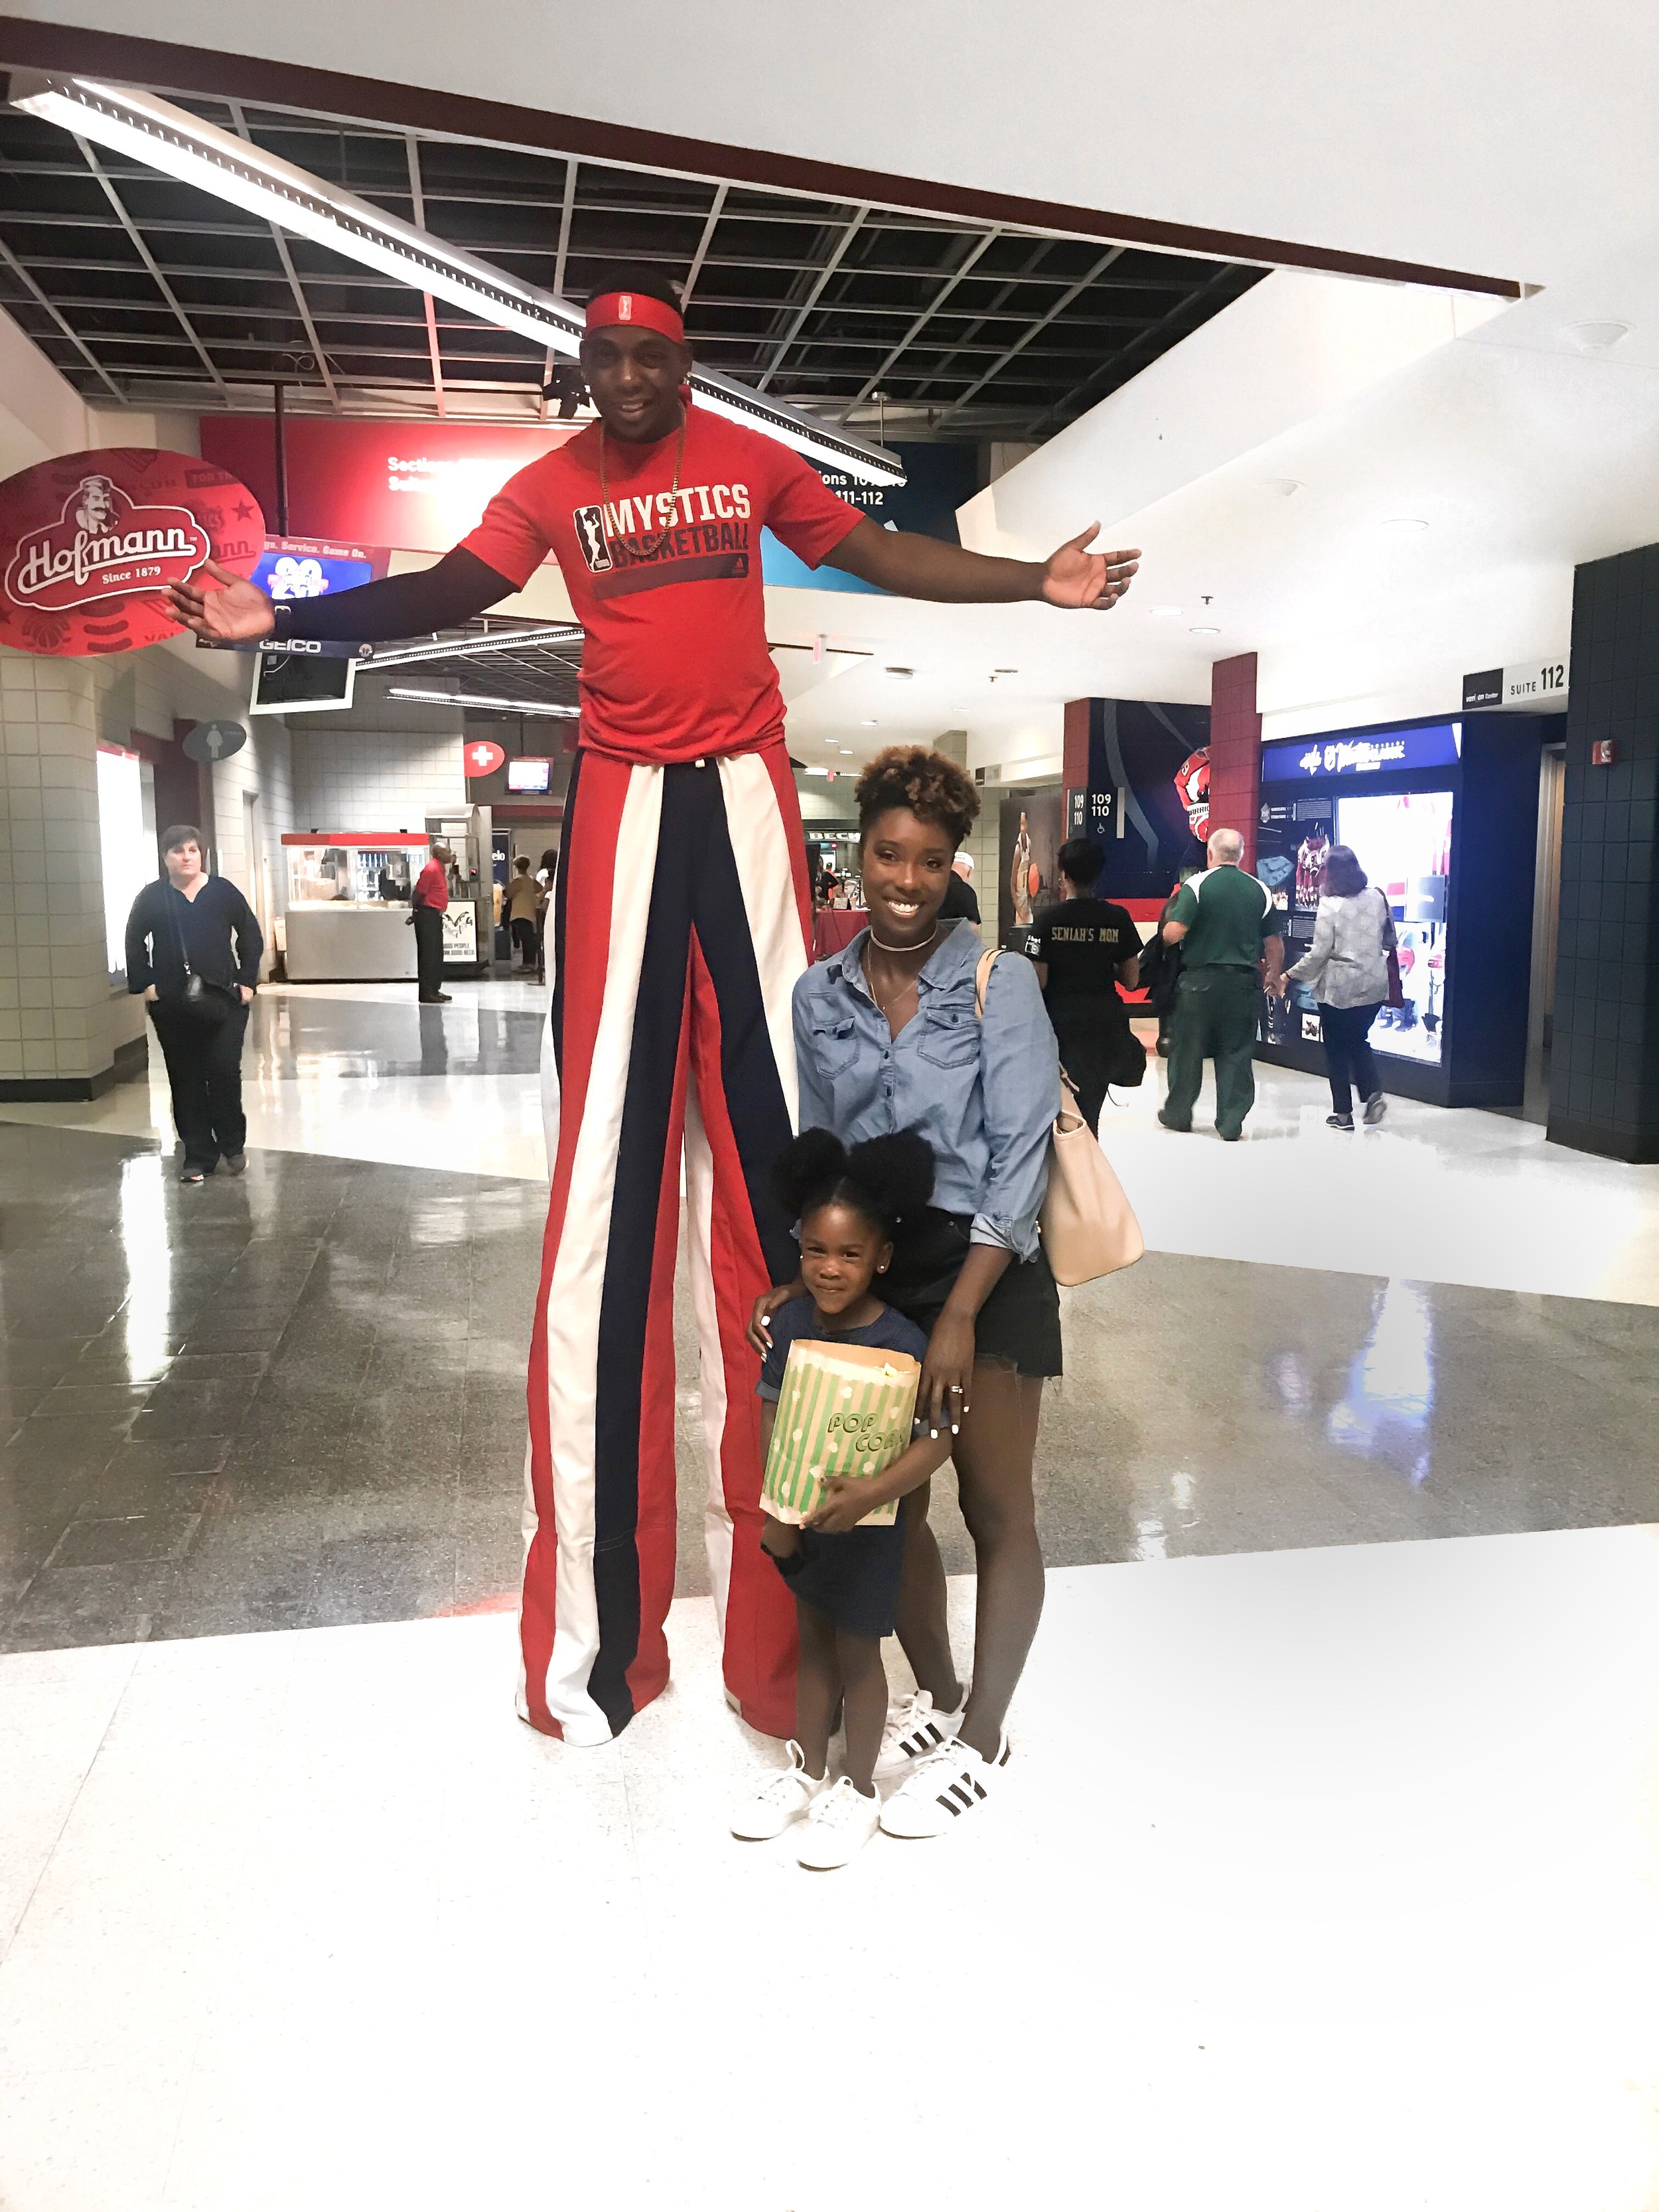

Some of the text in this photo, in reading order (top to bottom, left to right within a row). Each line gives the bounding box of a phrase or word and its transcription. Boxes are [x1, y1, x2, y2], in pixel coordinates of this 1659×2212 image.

[603, 484, 751, 538] MYSTICS
[281, 541, 320, 553] Service.
[323, 546, 349, 556] Game
[351, 548, 367, 559] On.
[610, 522, 749, 568] BASKETBALL
[17, 529, 196, 594] Hofmann
[102, 565, 161, 585] Since 1879
[259, 638, 322, 653] GEICO
[1510, 664, 1564, 695] SUITE 112
[1074, 794, 1084, 809] 109
[1092, 794, 1112, 804] 109
[1074, 811, 1083, 825] 110
[1091, 805, 1110, 816] 110
[1051, 926, 1119, 943] SENIAH'S MOM
[828, 1413, 878, 1433] POP
[855, 1430, 902, 1451] COR
